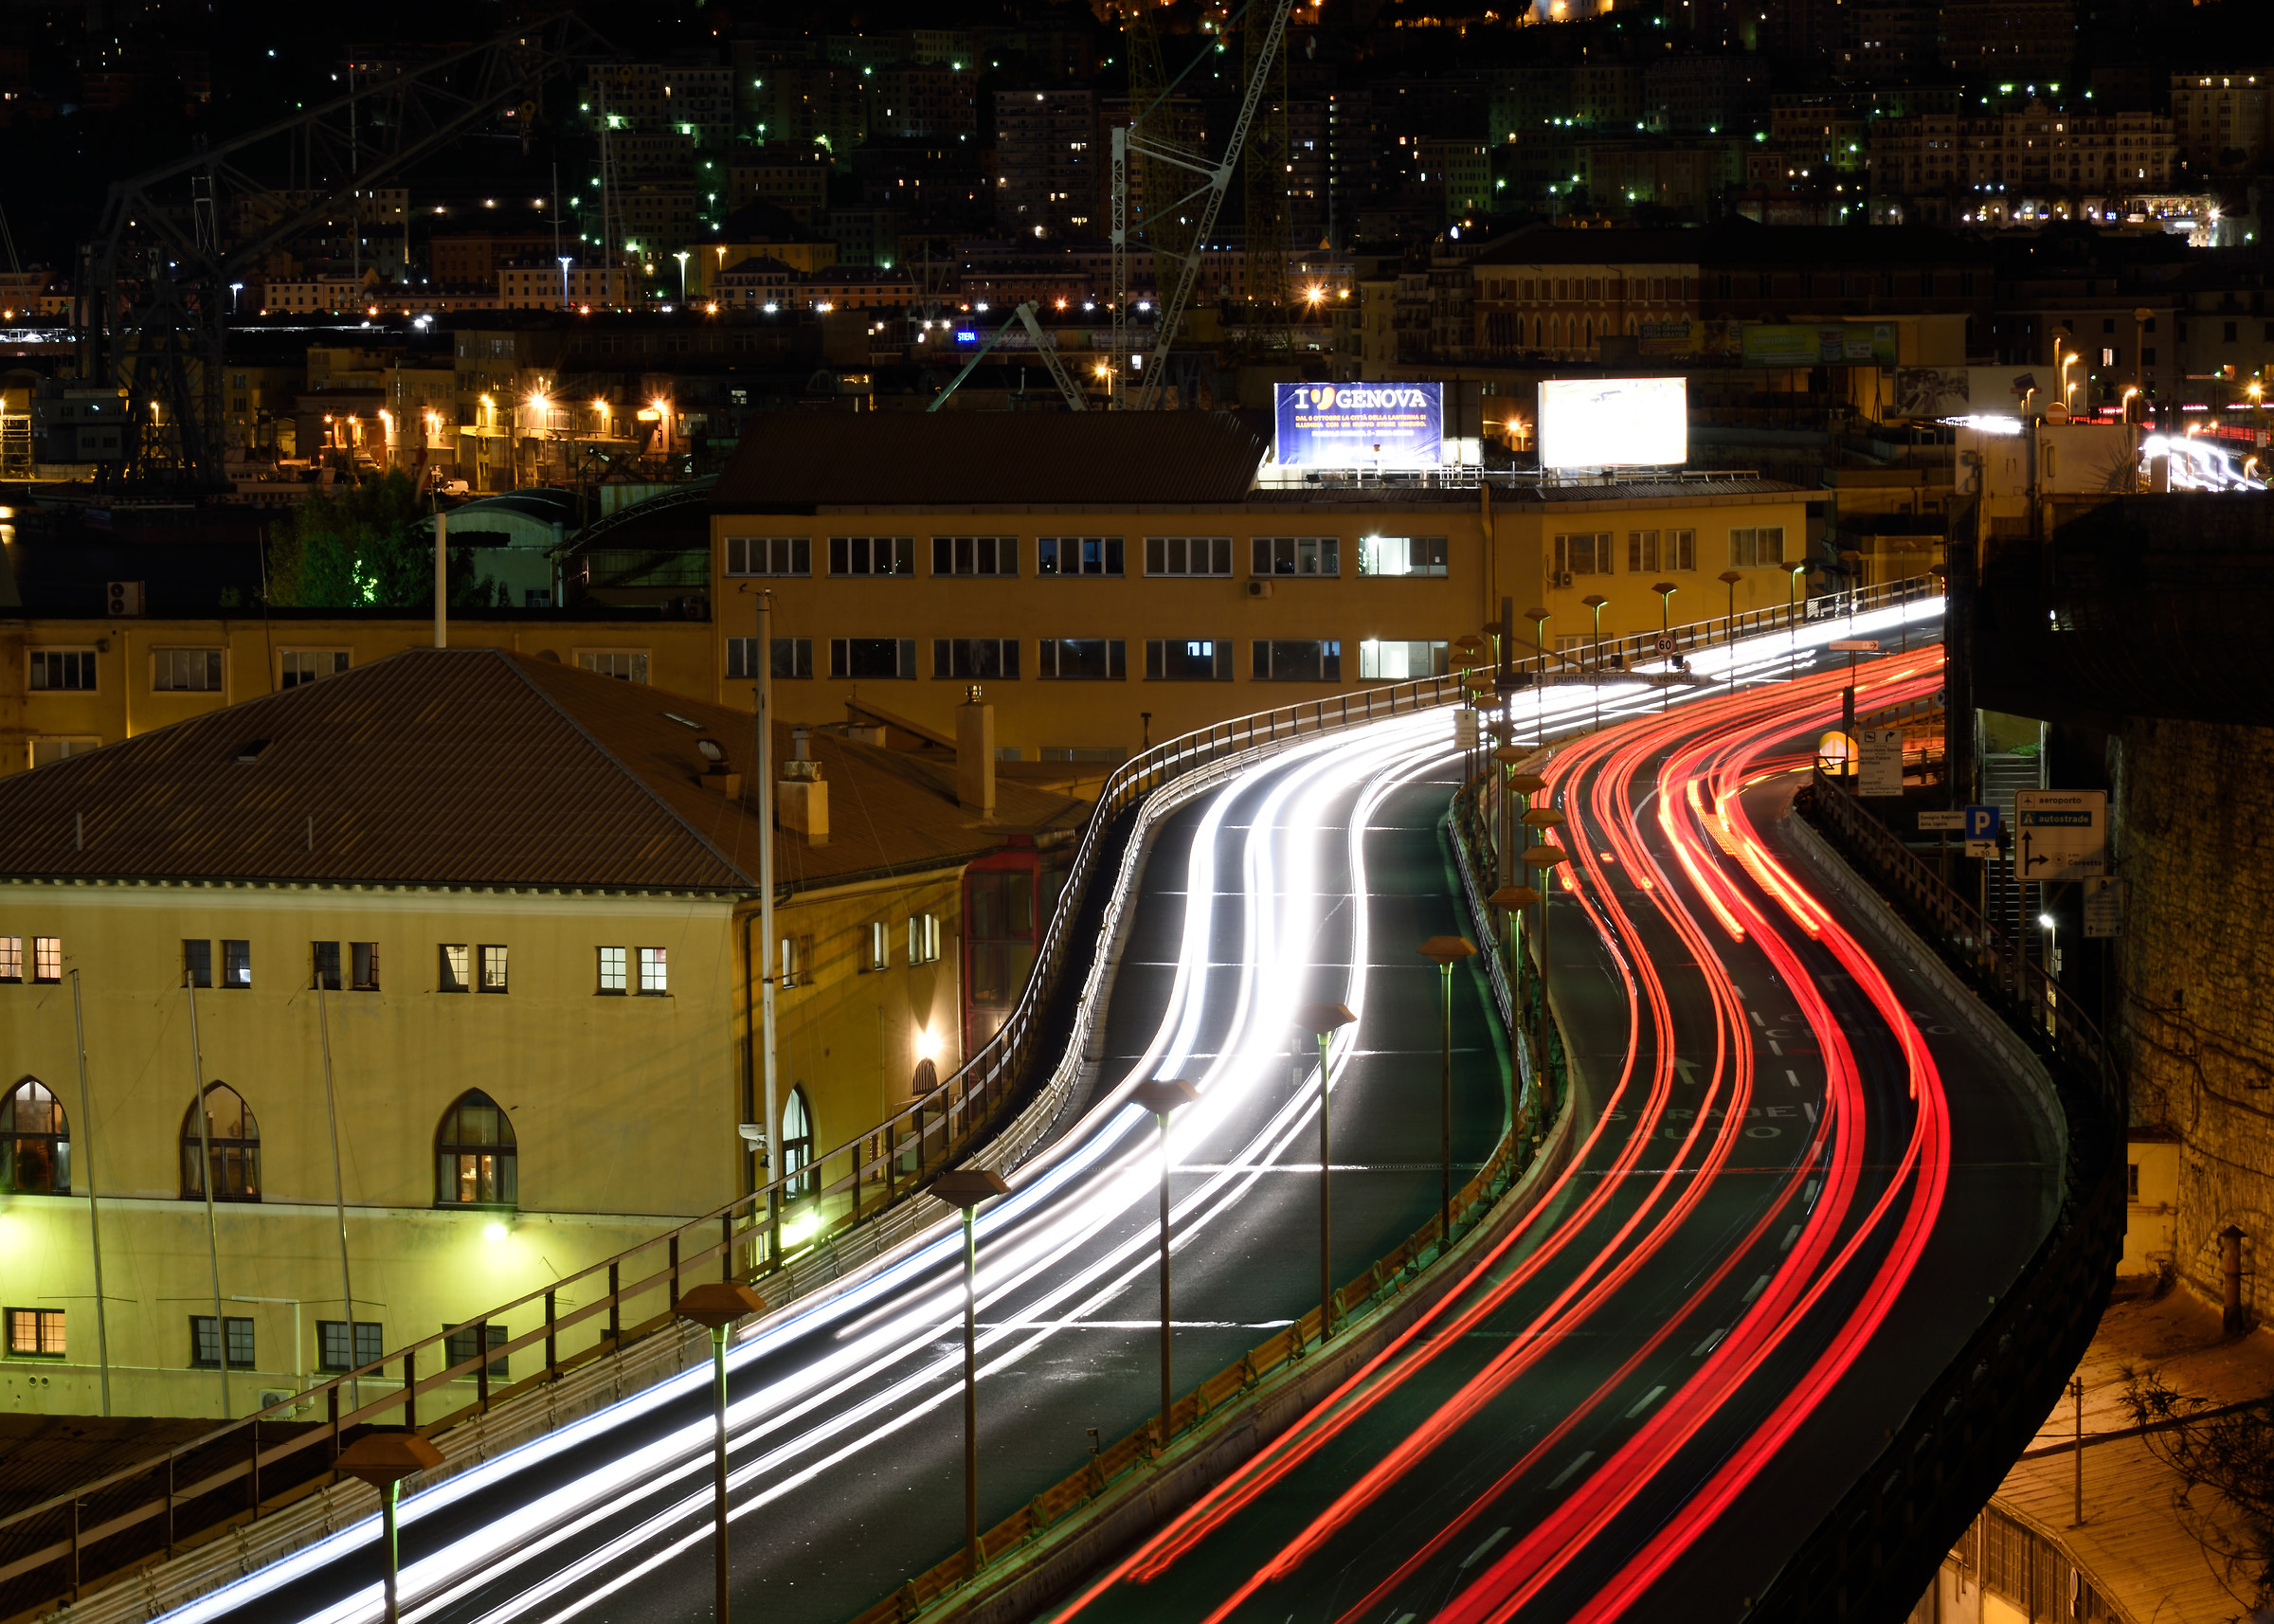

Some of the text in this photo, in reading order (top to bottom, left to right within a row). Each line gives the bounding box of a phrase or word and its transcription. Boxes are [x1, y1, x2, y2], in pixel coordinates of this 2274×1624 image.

[1294, 388, 1427, 409] I GENOVA
[1659, 640, 1671, 650] 60
[1553, 675, 1584, 684] punto
[1589, 674, 1653, 683] rilevamento
[1975, 811, 1991, 835] P
[2038, 814, 2089, 823] autostrade
